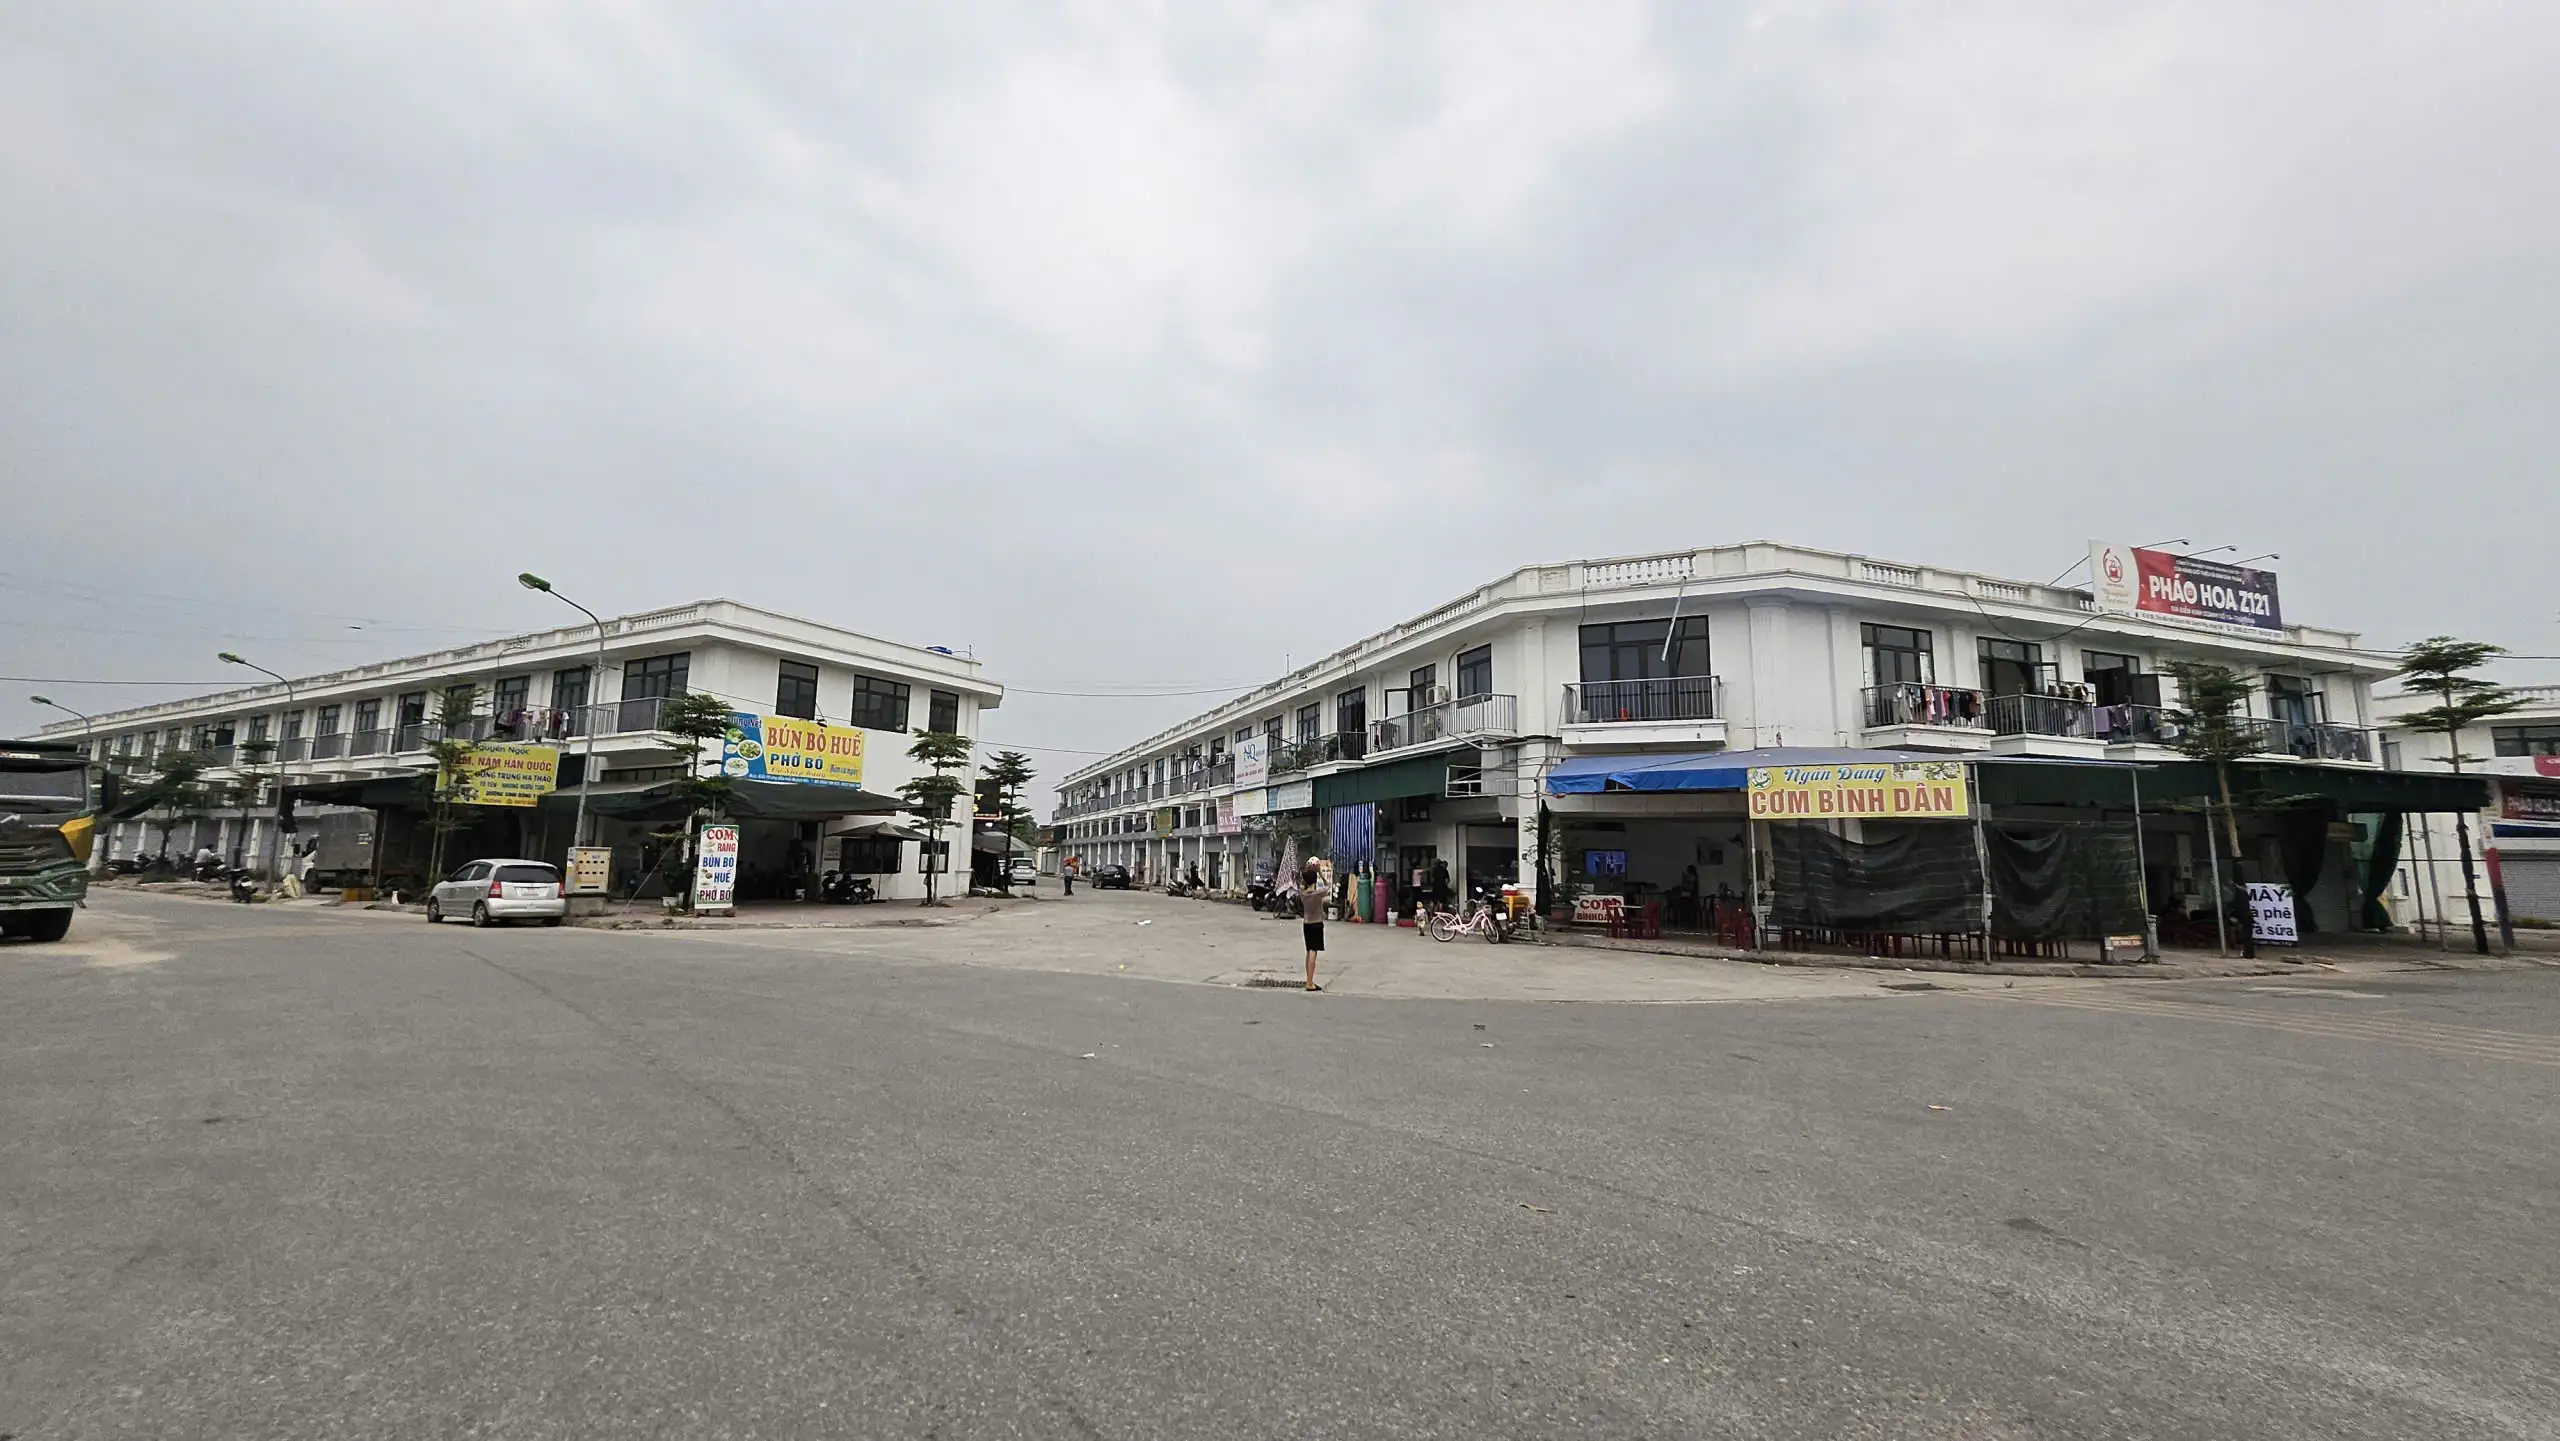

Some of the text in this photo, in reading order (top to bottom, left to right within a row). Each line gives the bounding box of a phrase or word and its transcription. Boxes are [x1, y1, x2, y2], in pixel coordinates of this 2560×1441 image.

[2149, 574, 2197, 604] PHÁO
[2200, 583, 2238, 612] HOA
[2239, 590, 2271, 616] Z121
[767, 723, 862, 757] BÚN BÒ HUẾ
[770, 752, 801, 768] PHỞ
[1751, 782, 1953, 815] CƠM BÌNH DÂN
[717, 843, 736, 852] RANG
[702, 854, 735, 868] BÚN BÒ
[713, 869, 732, 883] HUẾ
[699, 886, 718, 901] PHỞ
[2263, 907, 2292, 921] phê
[2267, 924, 2295, 937] sữa
